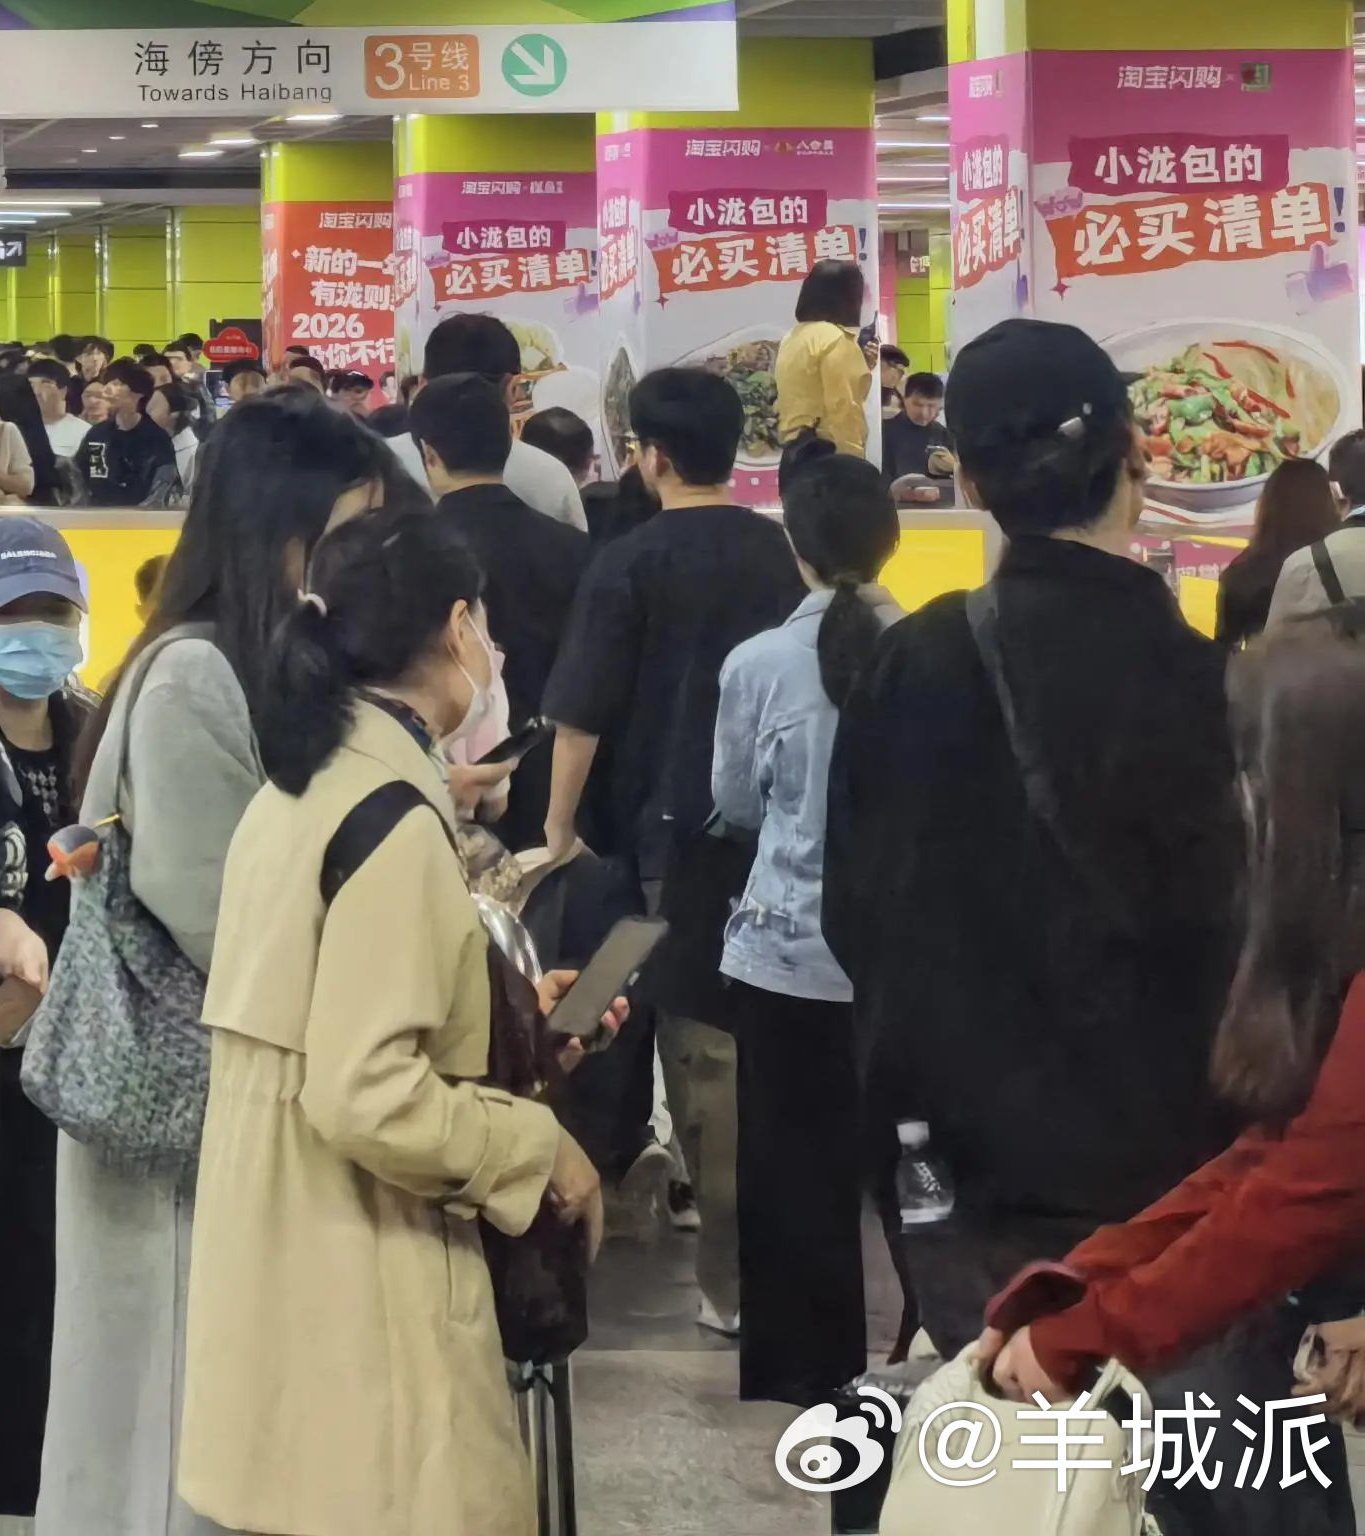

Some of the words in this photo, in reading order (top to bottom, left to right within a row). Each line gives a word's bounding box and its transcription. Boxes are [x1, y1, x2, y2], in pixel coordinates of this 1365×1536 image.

[133, 39, 332, 77] 海傍方向
[374, 42, 471, 92] 3号线
[408, 74, 451, 92] Line
[1117, 65, 1222, 89] 淘宝闪购
[138, 84, 229, 102] Towards
[241, 83, 333, 104] Haibang
[684, 139, 762, 157] 淘宝闪购
[1094, 143, 1263, 185] 小泷包的
[686, 195, 809, 227] 小泷包的
[456, 225, 552, 249] 小泷包的
[292, 313, 365, 339] 2026
